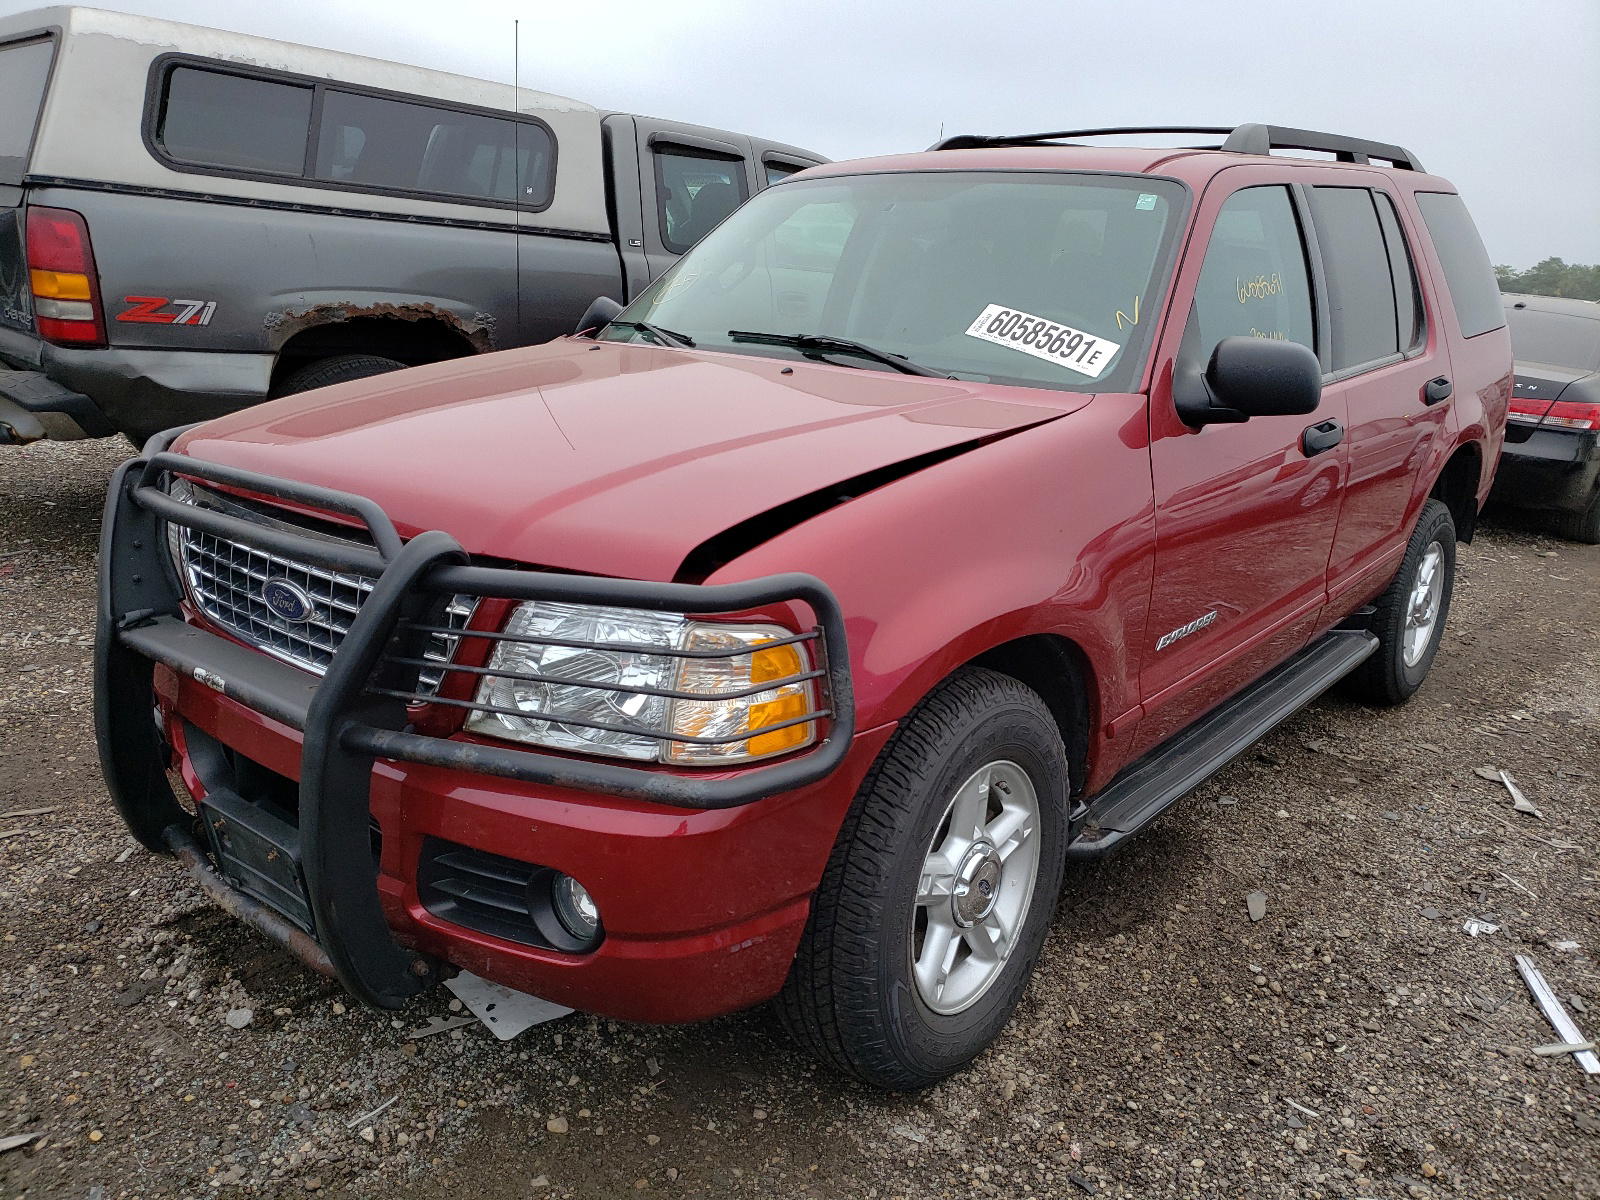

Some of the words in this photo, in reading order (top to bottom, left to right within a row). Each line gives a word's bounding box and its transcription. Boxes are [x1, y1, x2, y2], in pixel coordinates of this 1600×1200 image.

[115, 296, 217, 326] Z71
[986, 310, 1096, 364] 60585691
[1087, 350, 1103, 366] E
[272, 588, 297, 613] Ford
